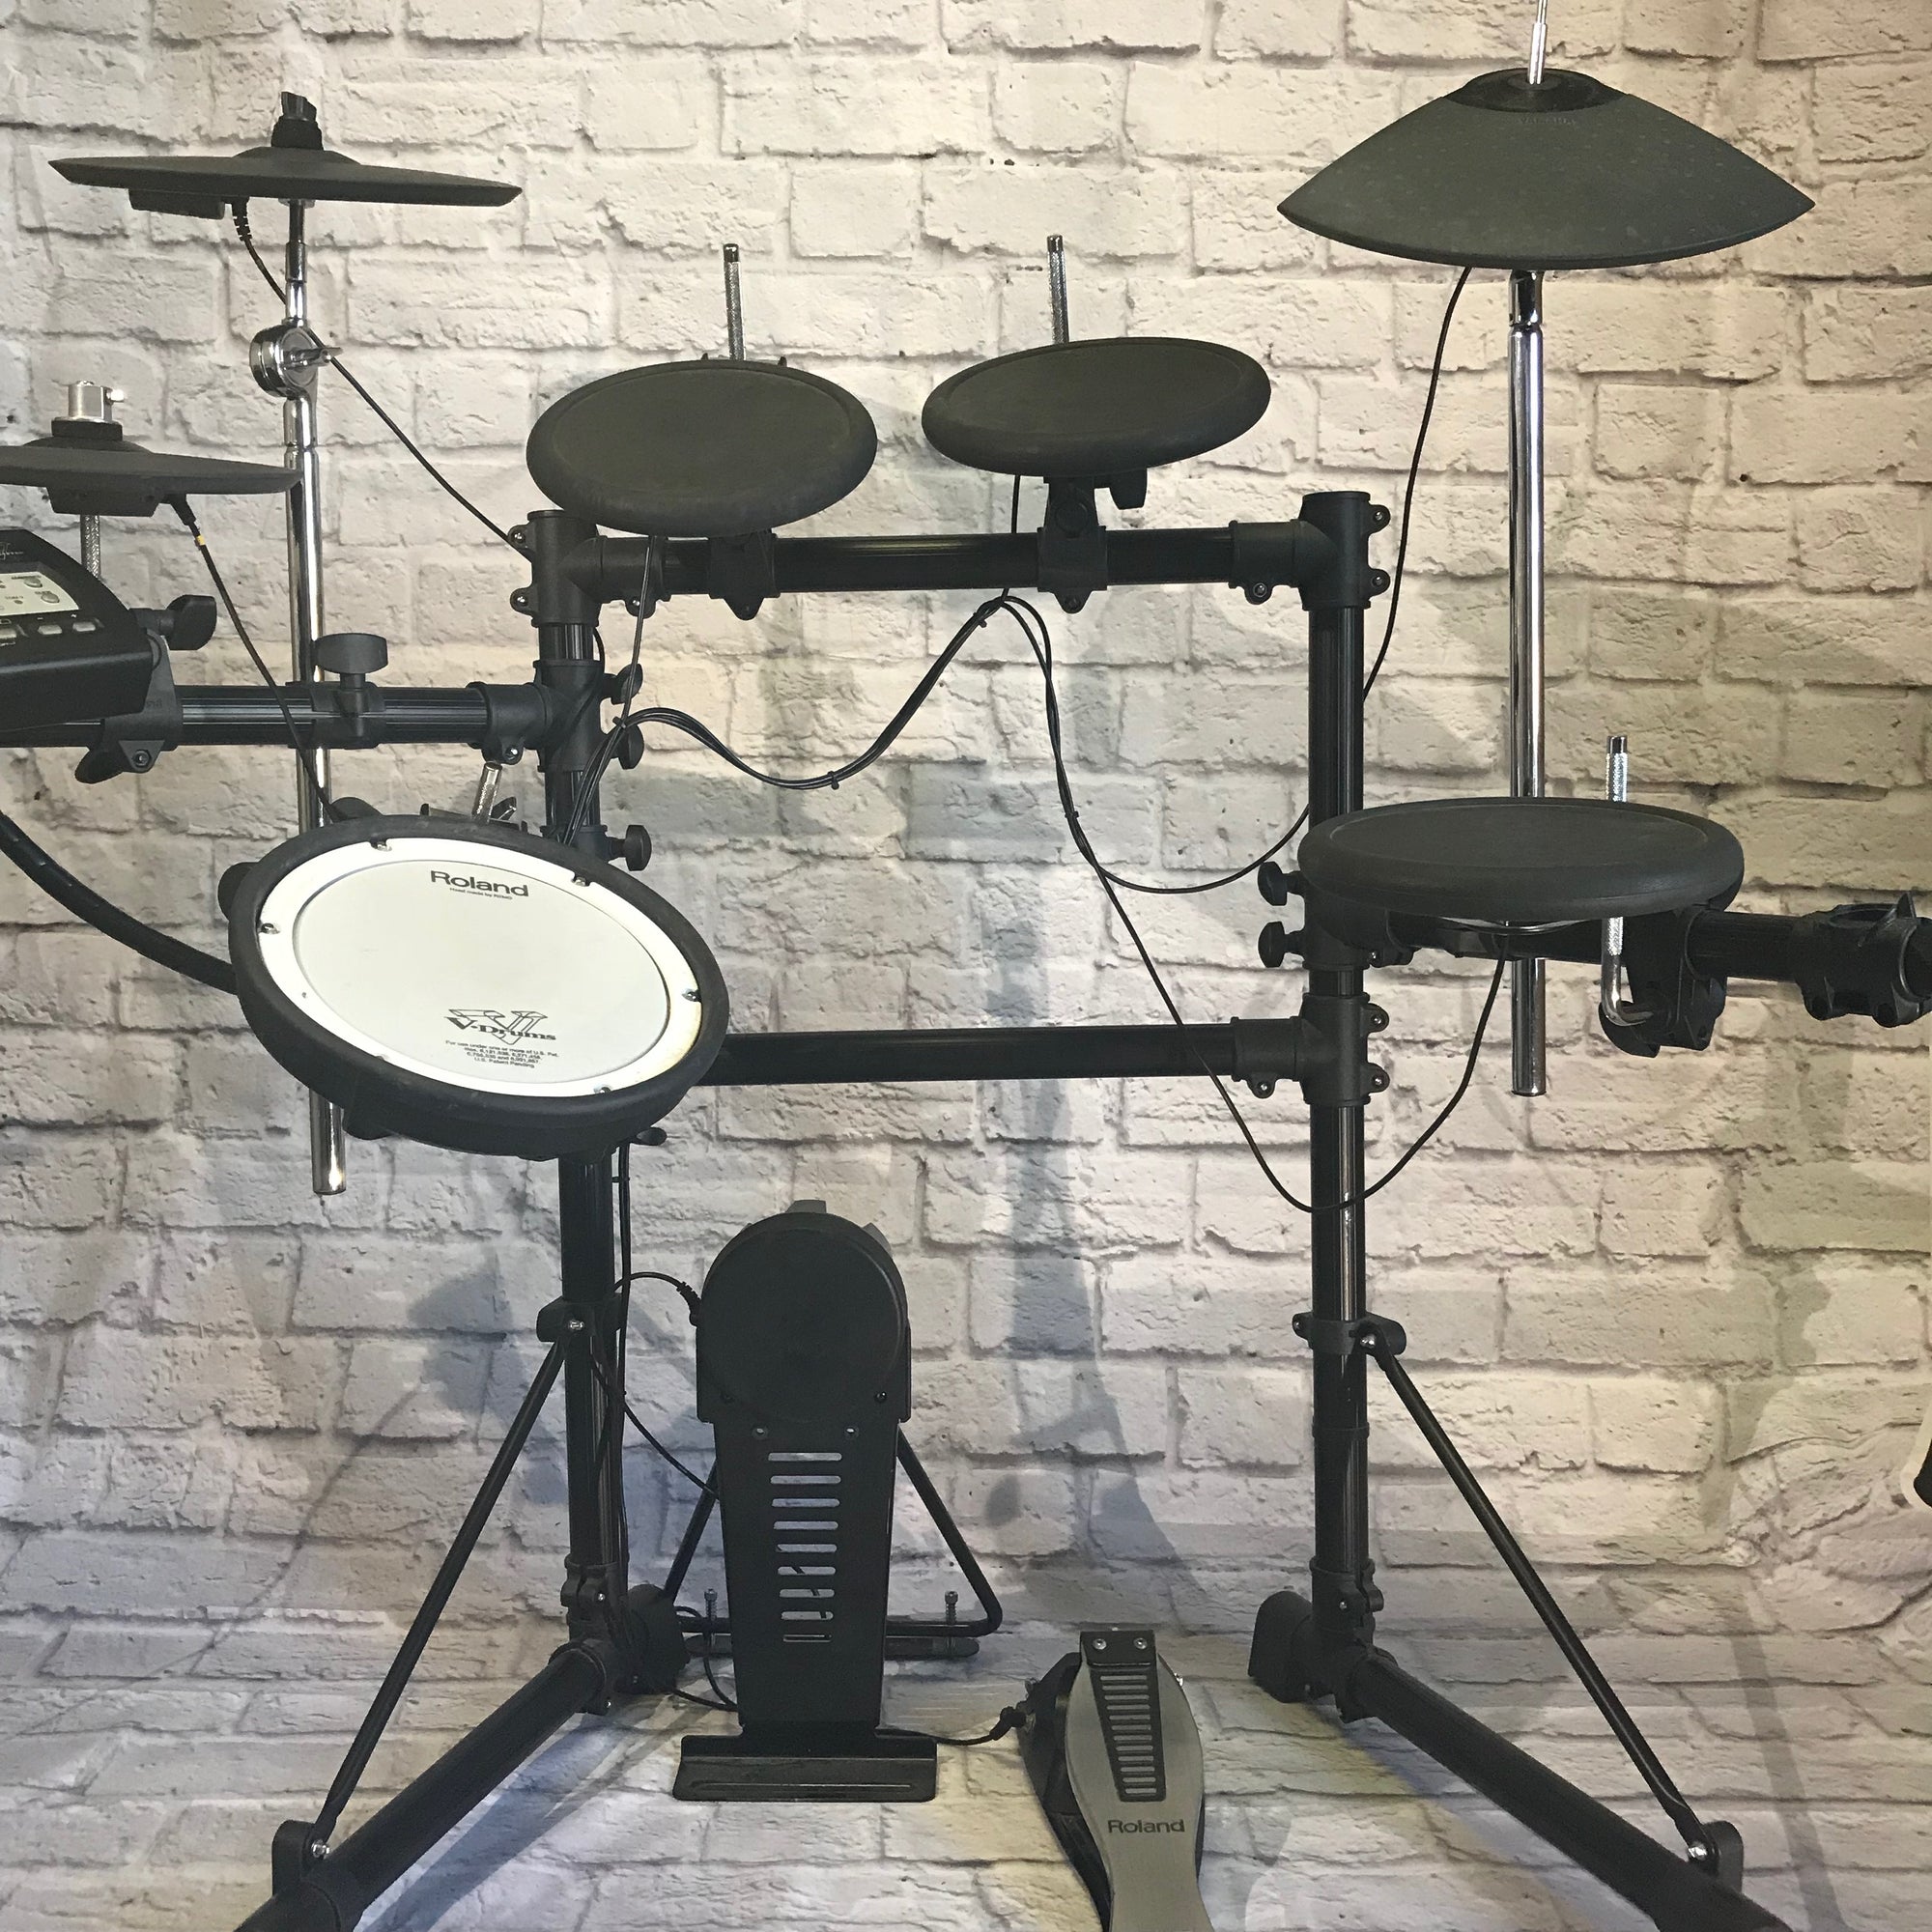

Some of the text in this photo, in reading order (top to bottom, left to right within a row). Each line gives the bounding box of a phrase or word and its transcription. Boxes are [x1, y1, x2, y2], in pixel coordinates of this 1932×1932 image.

[431, 870, 529, 896] Roland
[444, 1016, 556, 1040] V-Drums
[1107, 1819, 1185, 1833] Roland
